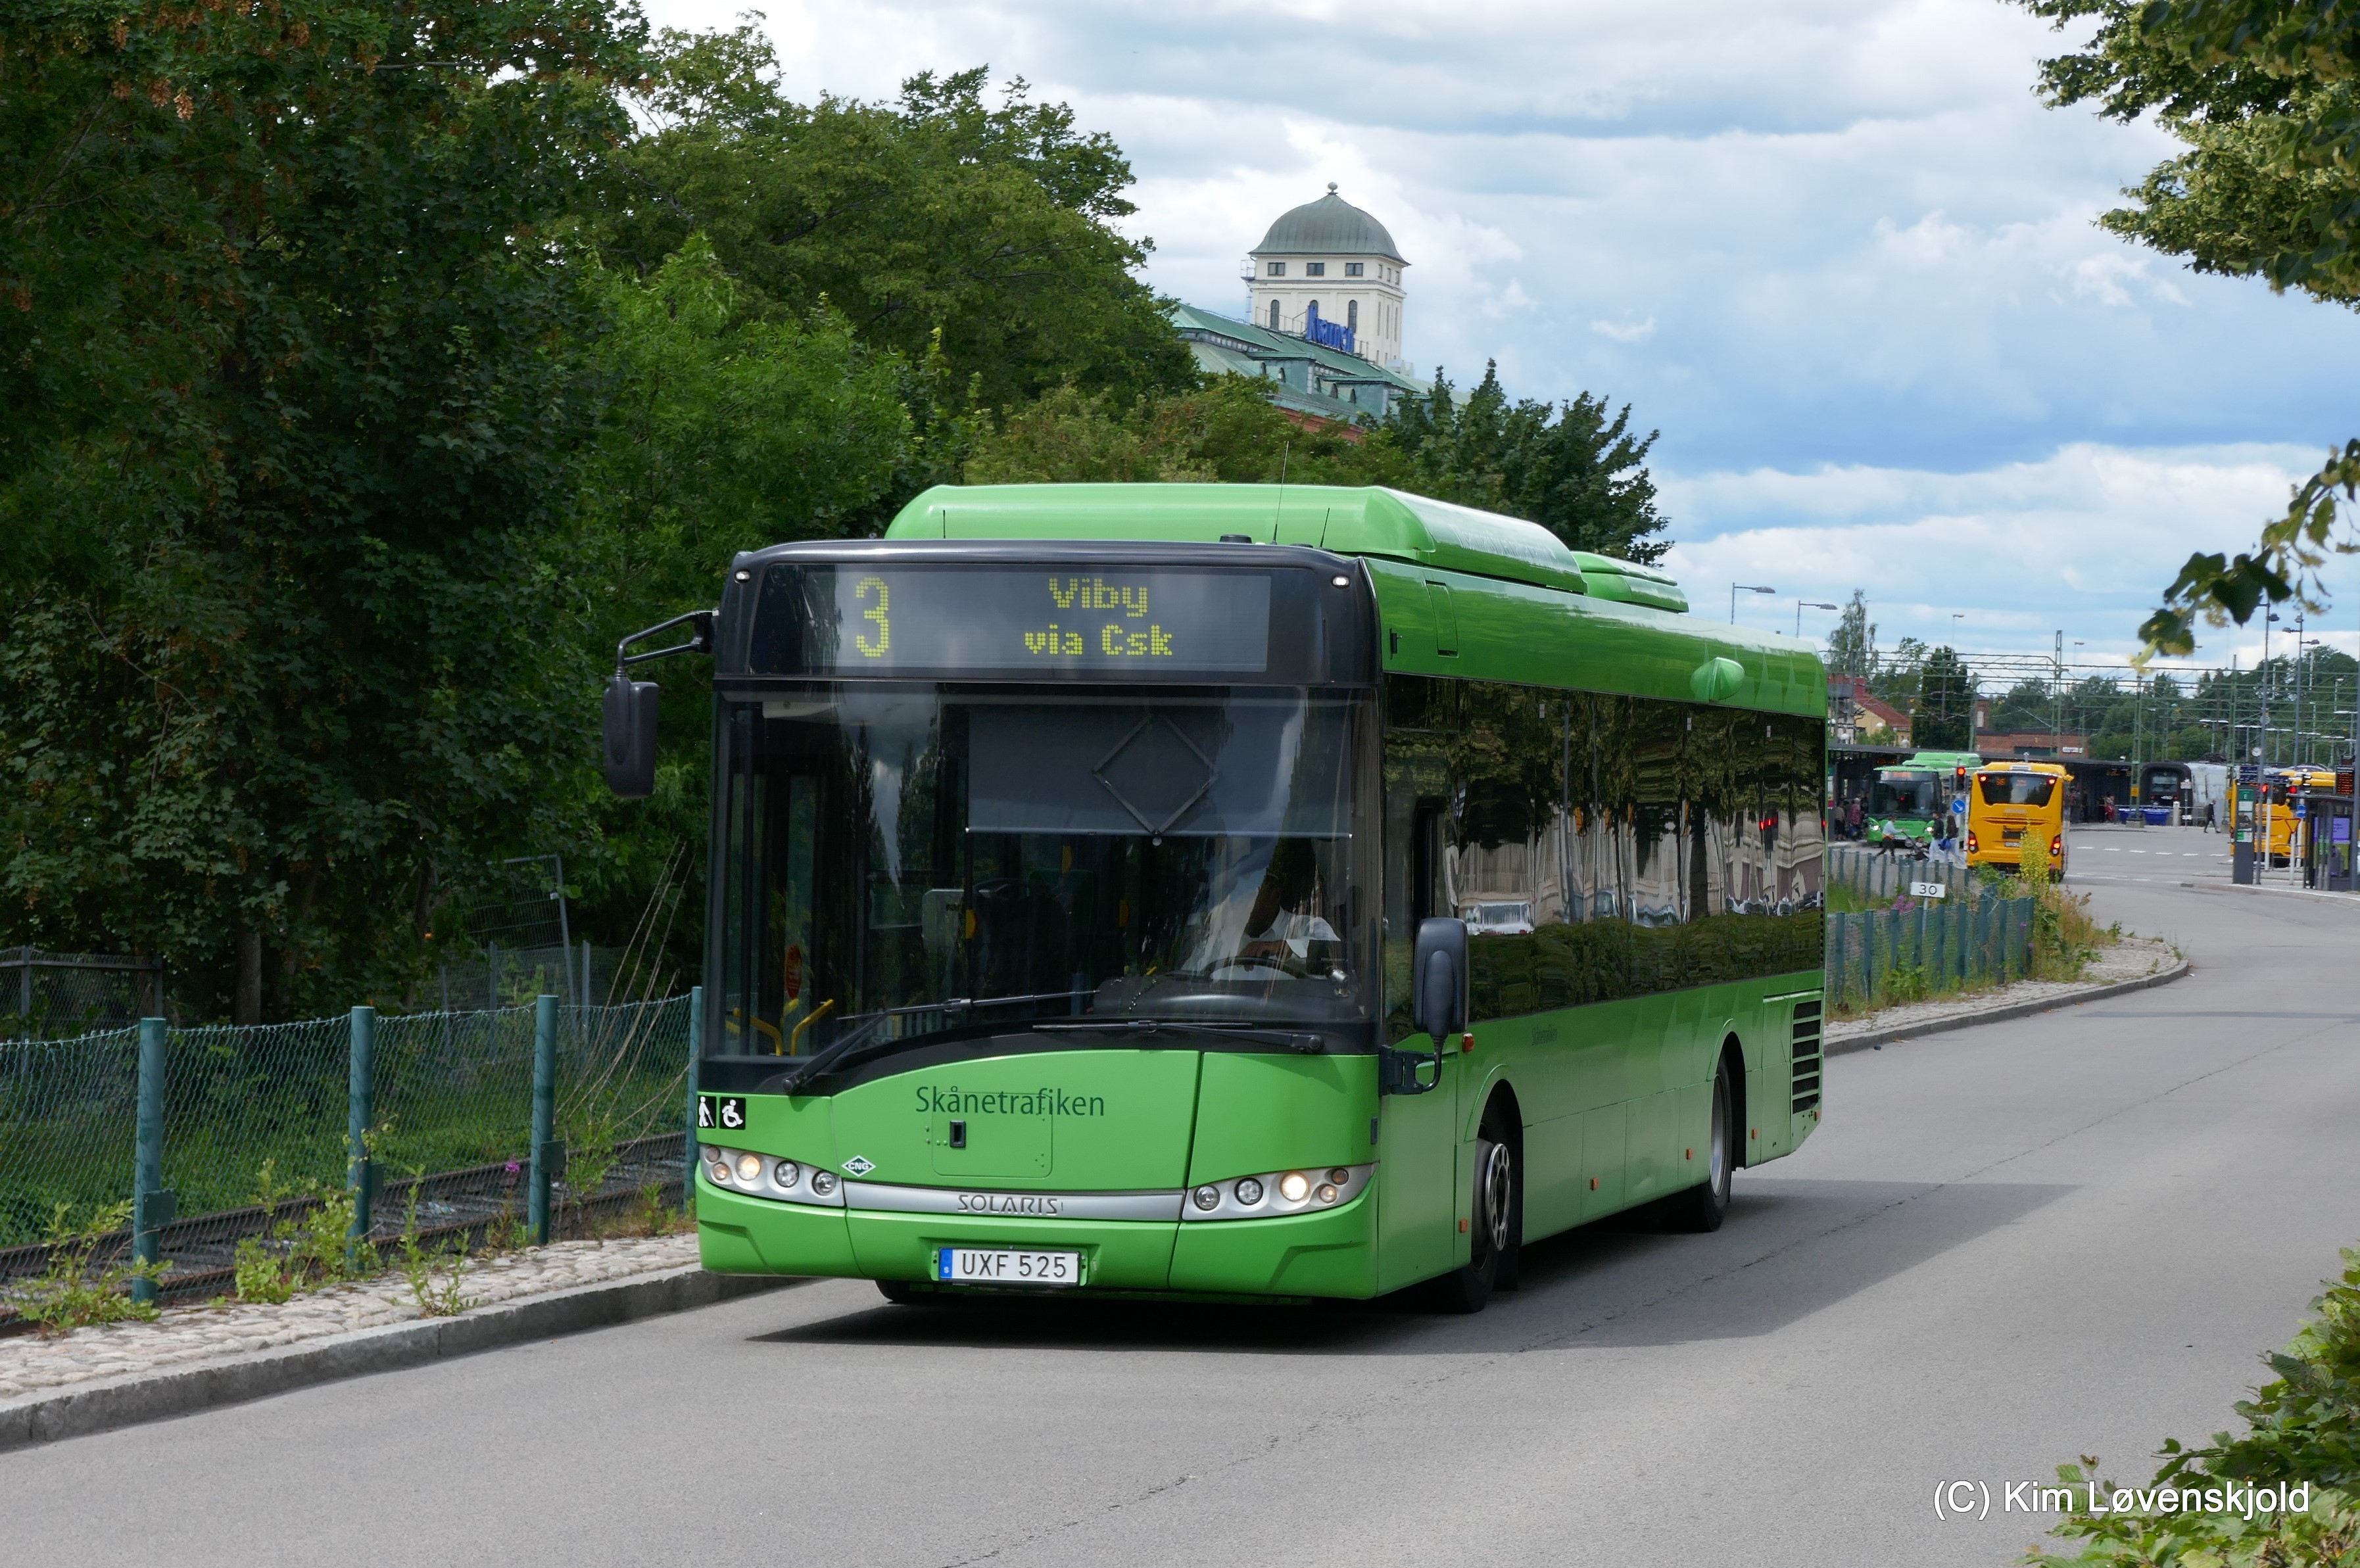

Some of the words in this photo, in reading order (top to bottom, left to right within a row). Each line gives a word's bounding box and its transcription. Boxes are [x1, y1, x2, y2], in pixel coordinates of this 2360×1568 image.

[1049, 578, 1147, 617] Viby
[855, 577, 890, 657] 3
[1024, 624, 1083, 655] via
[1101, 624, 1172, 655] Csk
[1919, 884, 1937, 895] 30
[915, 1085, 1105, 1116] Skånetrafiken
[848, 1162, 870, 1172] CNG
[957, 1194, 1058, 1215] SOLARIS
[962, 1252, 1009, 1277] UXF
[1019, 1254, 1067, 1278] 525
